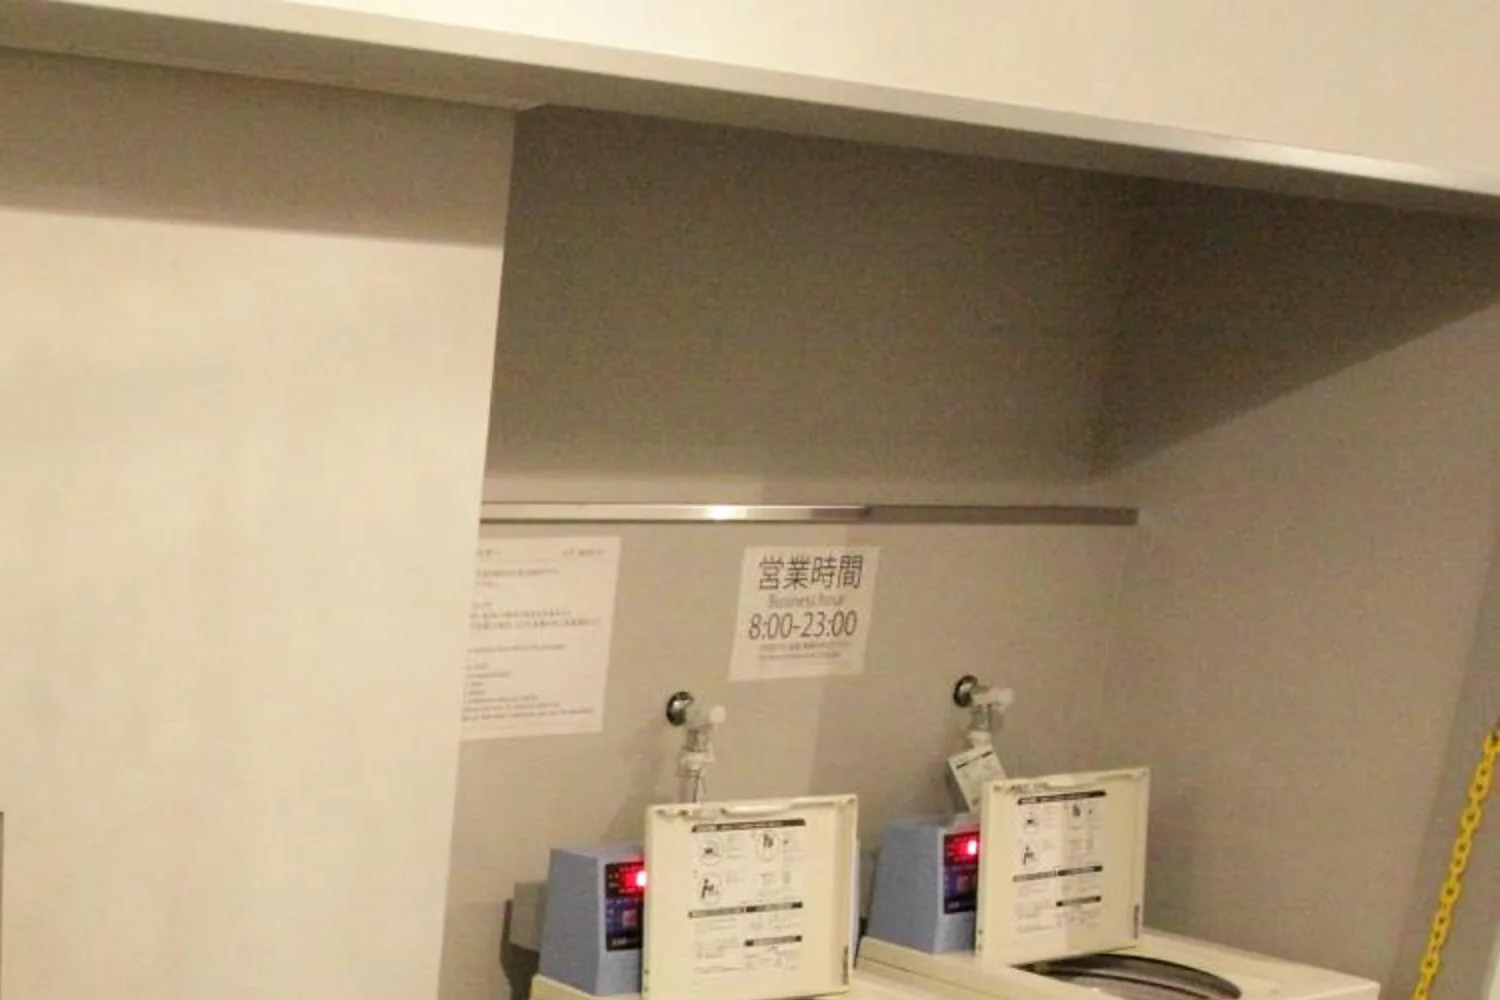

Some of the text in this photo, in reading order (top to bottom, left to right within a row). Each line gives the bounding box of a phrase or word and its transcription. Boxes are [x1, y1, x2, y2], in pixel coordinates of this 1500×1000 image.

[759, 551, 864, 591] 営業時間
[748, 609, 858, 641] 8:00-23:00
